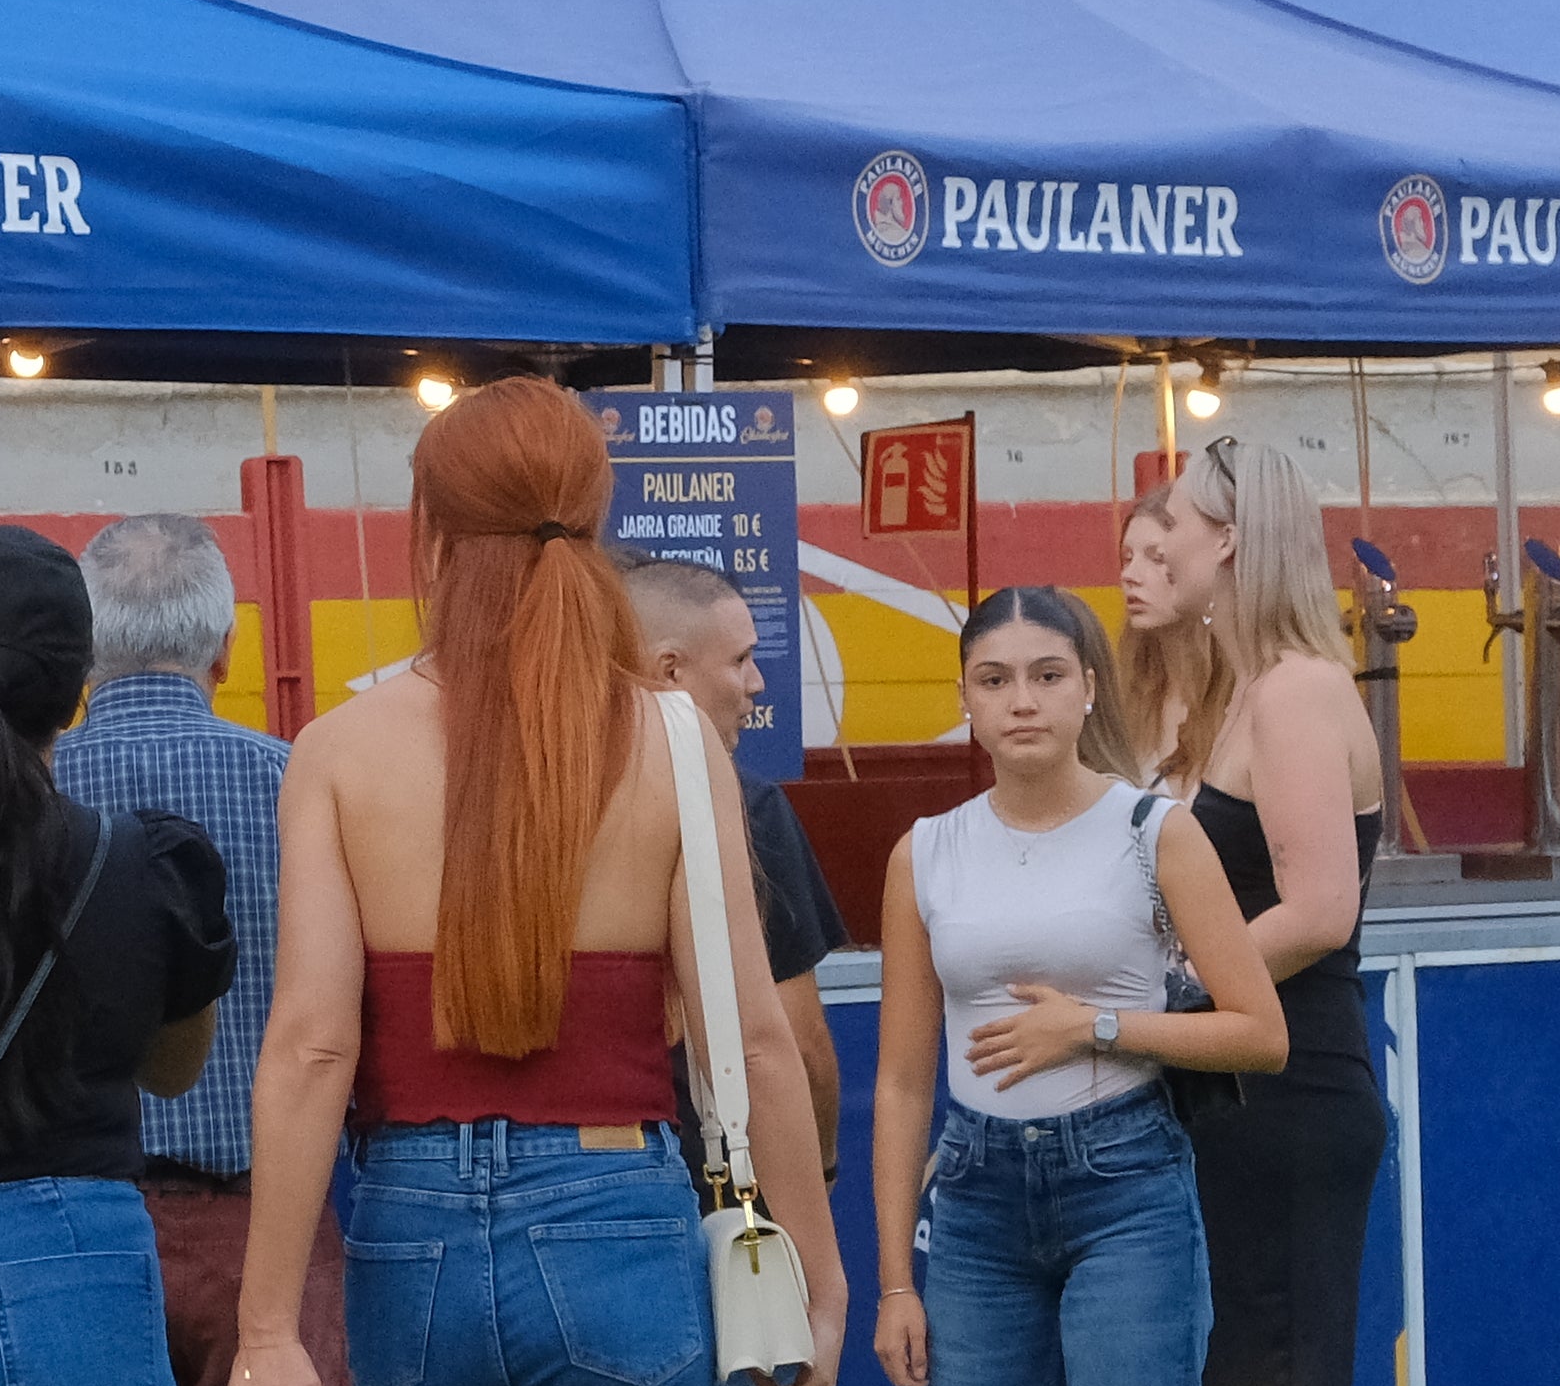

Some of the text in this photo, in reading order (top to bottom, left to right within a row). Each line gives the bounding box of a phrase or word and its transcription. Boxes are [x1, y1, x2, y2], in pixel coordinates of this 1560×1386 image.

[941, 176, 1243, 257] PAULANER
[639, 405, 737, 444] BEBIDAS
[643, 472, 735, 502] PAULANER
[617, 515, 665, 538] JARRA
[668, 514, 723, 538] GRANDE
